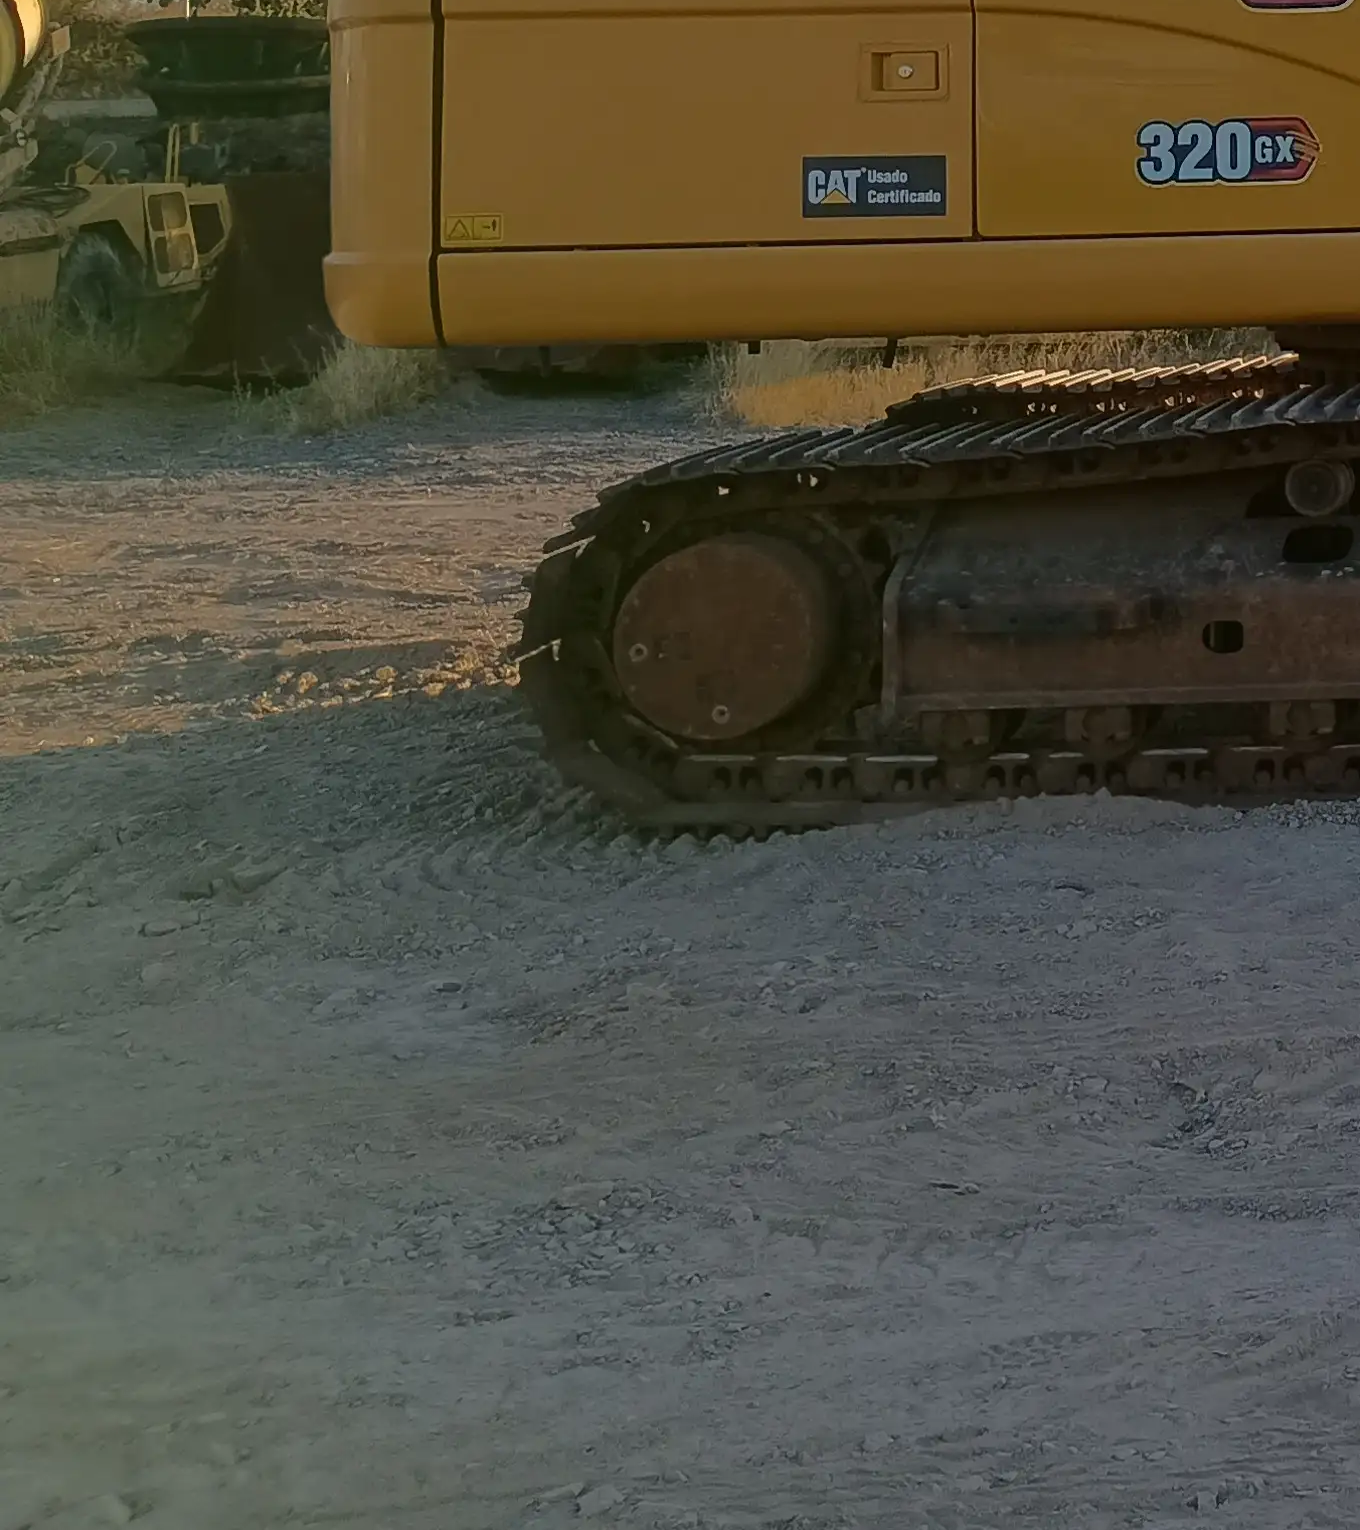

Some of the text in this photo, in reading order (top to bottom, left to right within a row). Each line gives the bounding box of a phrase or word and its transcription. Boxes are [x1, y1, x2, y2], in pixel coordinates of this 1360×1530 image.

[867, 169, 908, 183] Usado
[808, 169, 862, 204] CAT
[867, 189, 942, 203] Certificado
